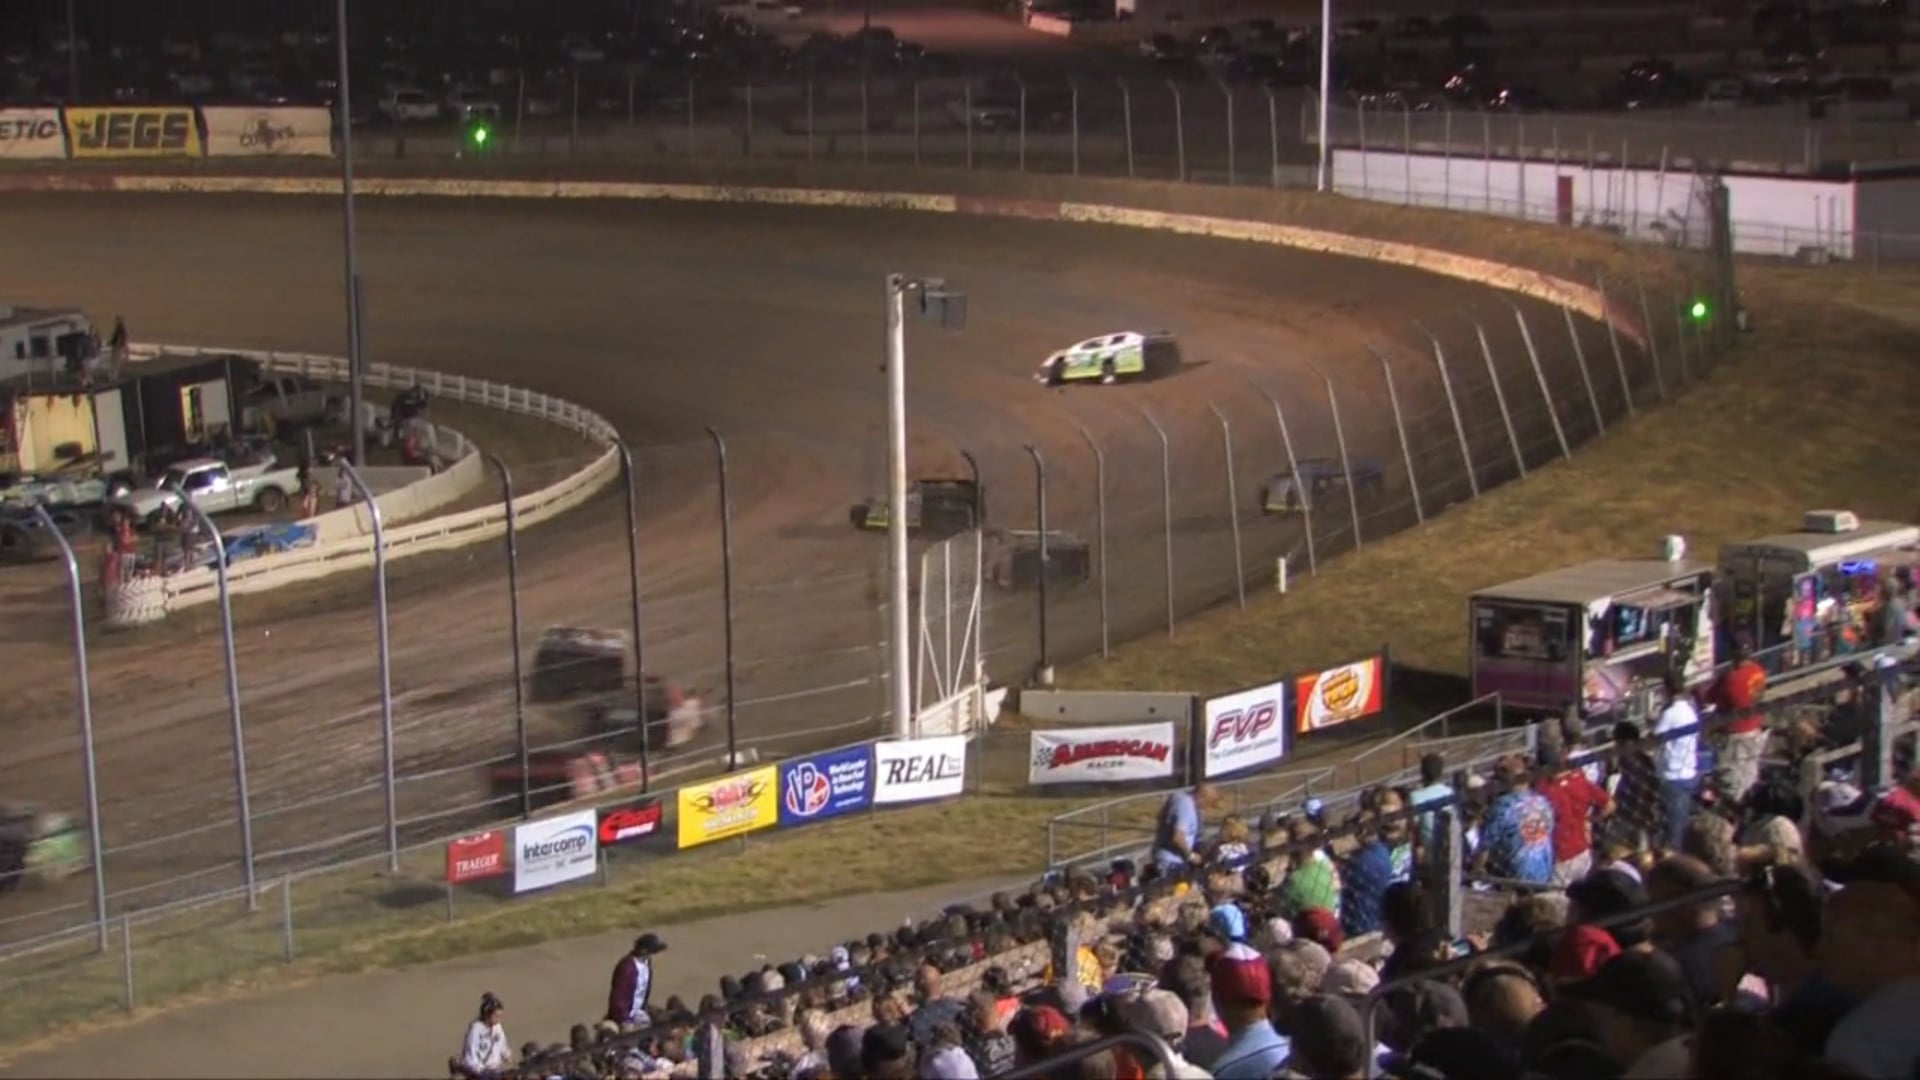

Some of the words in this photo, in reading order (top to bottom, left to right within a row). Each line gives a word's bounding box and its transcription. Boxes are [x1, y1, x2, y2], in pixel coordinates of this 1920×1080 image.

[78, 112, 189, 148] JEGS
[1209, 700, 1277, 749] FVP
[881, 753, 961, 786] REAL
[1048, 739, 1170, 769] AMERICAN
[786, 762, 818, 816] VP
[456, 854, 499, 873] TRAEGER
[523, 834, 587, 861] Intercomp
